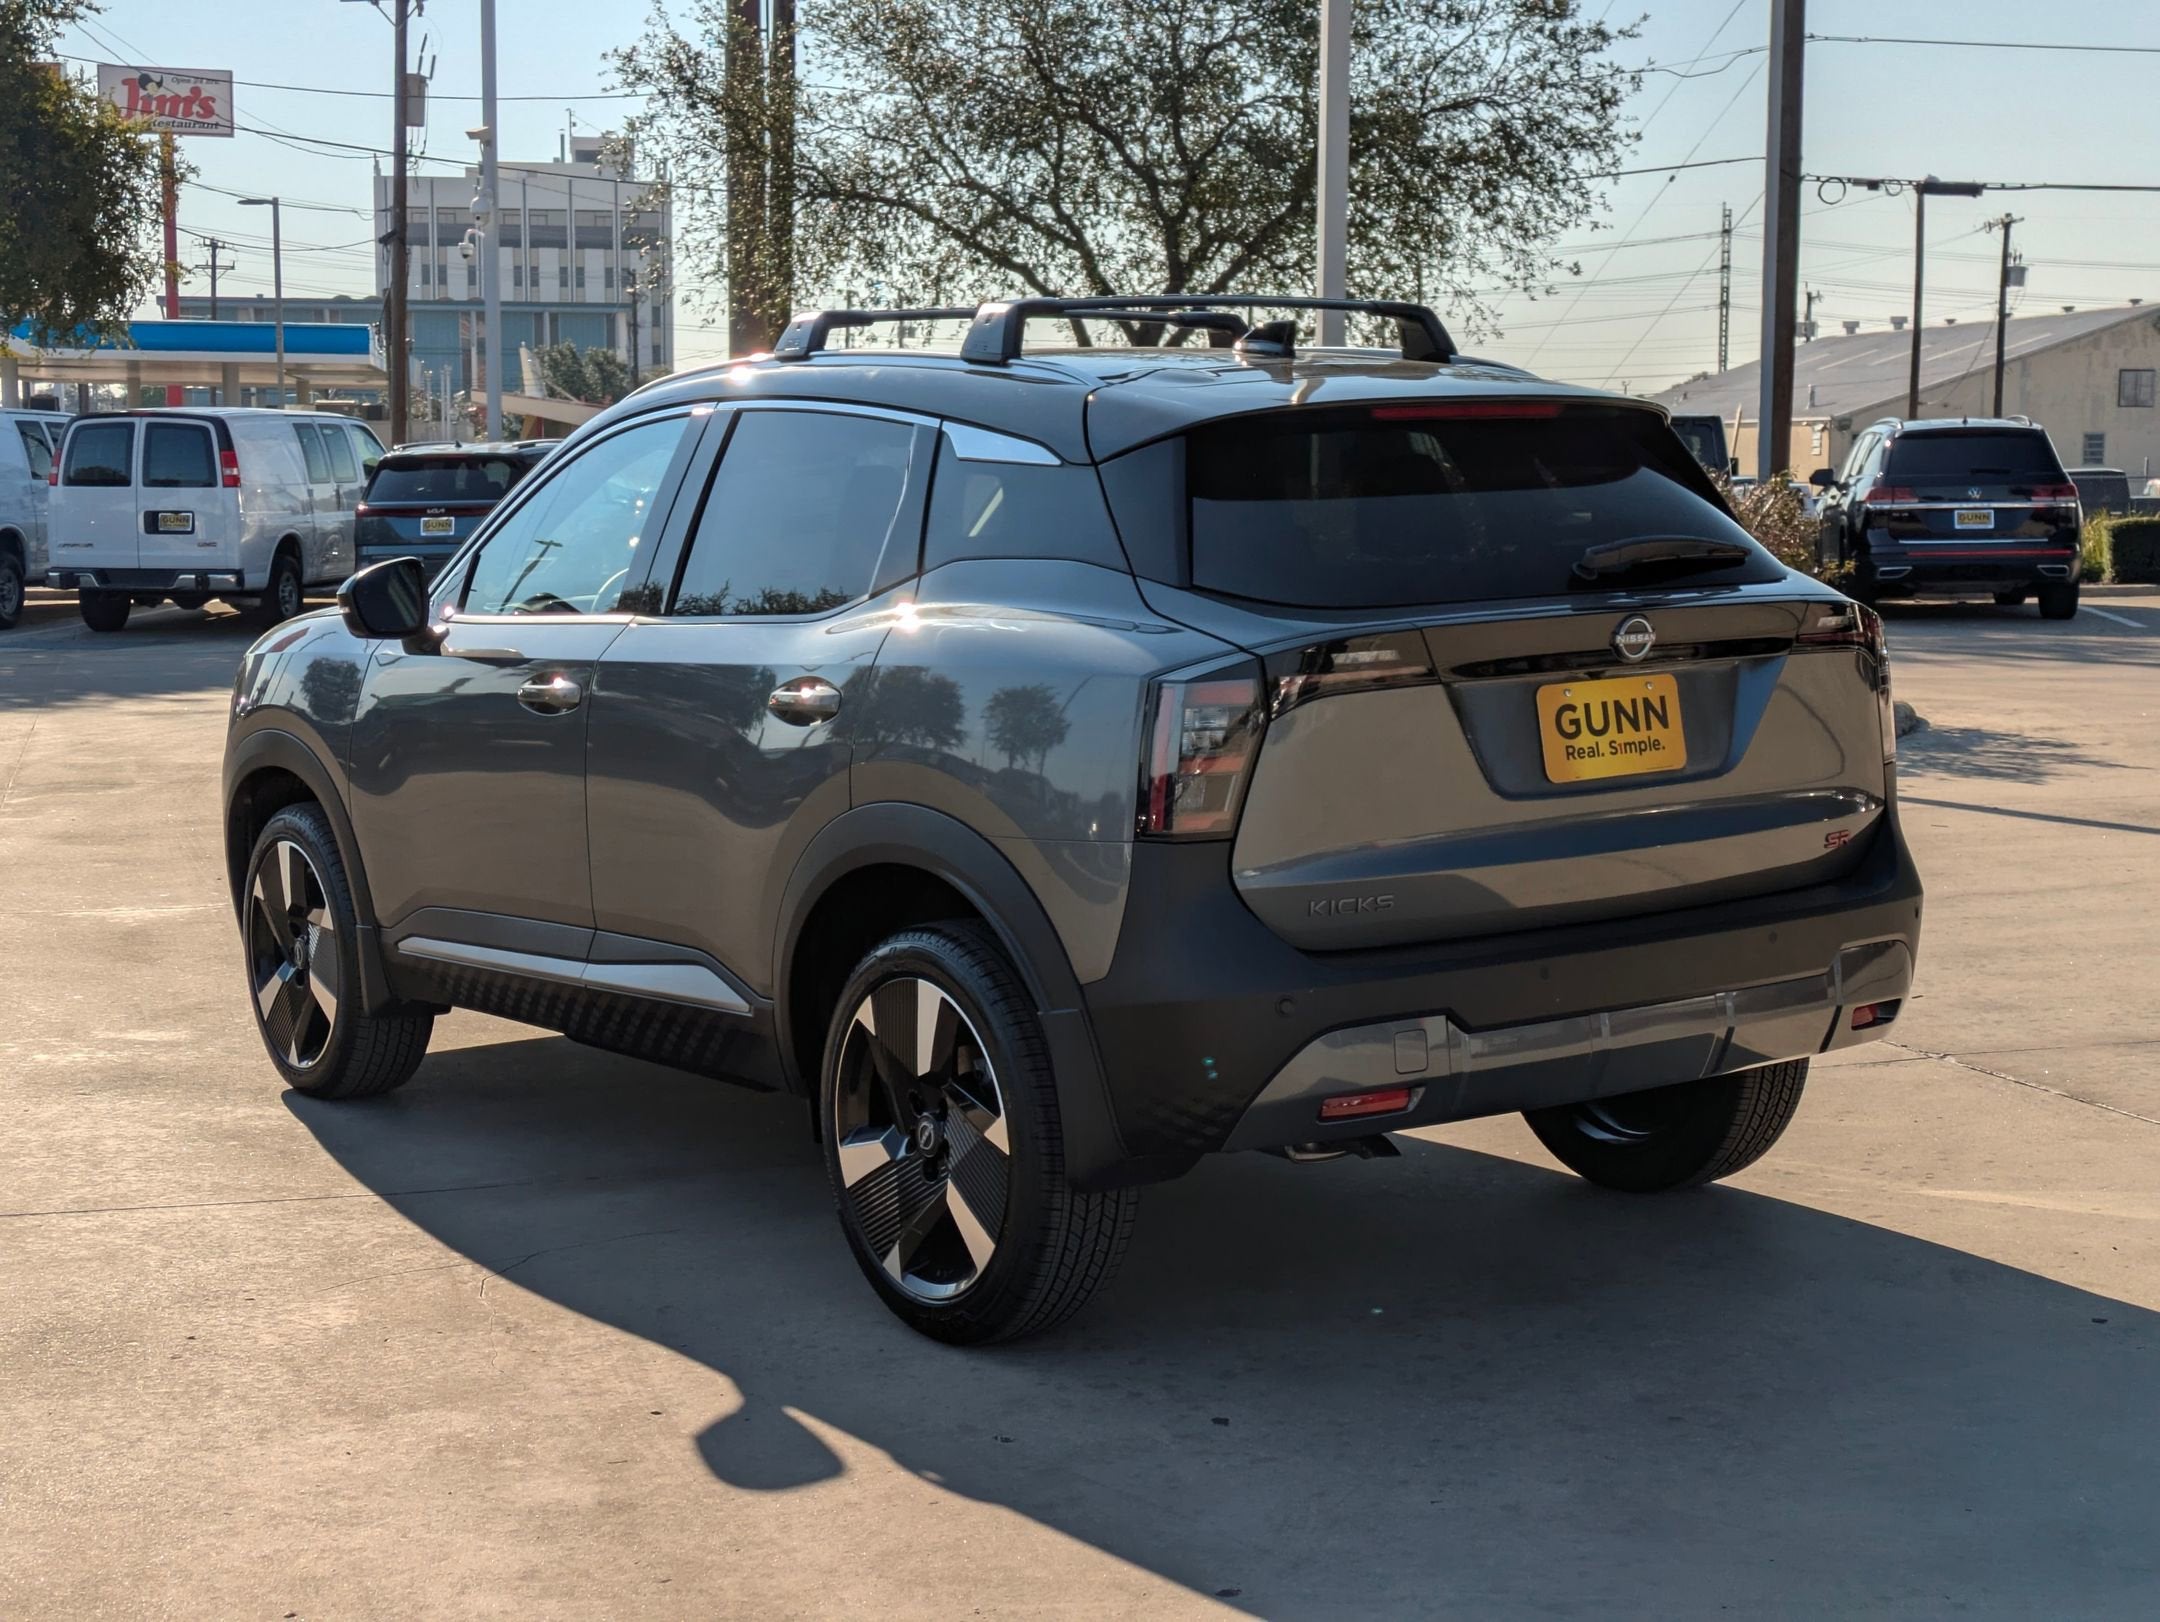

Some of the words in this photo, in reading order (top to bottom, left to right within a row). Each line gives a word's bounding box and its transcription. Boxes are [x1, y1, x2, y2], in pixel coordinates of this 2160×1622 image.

[121, 77, 216, 120] Jim's
[1615, 632, 1656, 644] NISSAN
[1555, 695, 1669, 740] GUNN
[1565, 741, 1605, 761] Real.
[1307, 894, 1394, 917] KICKS
